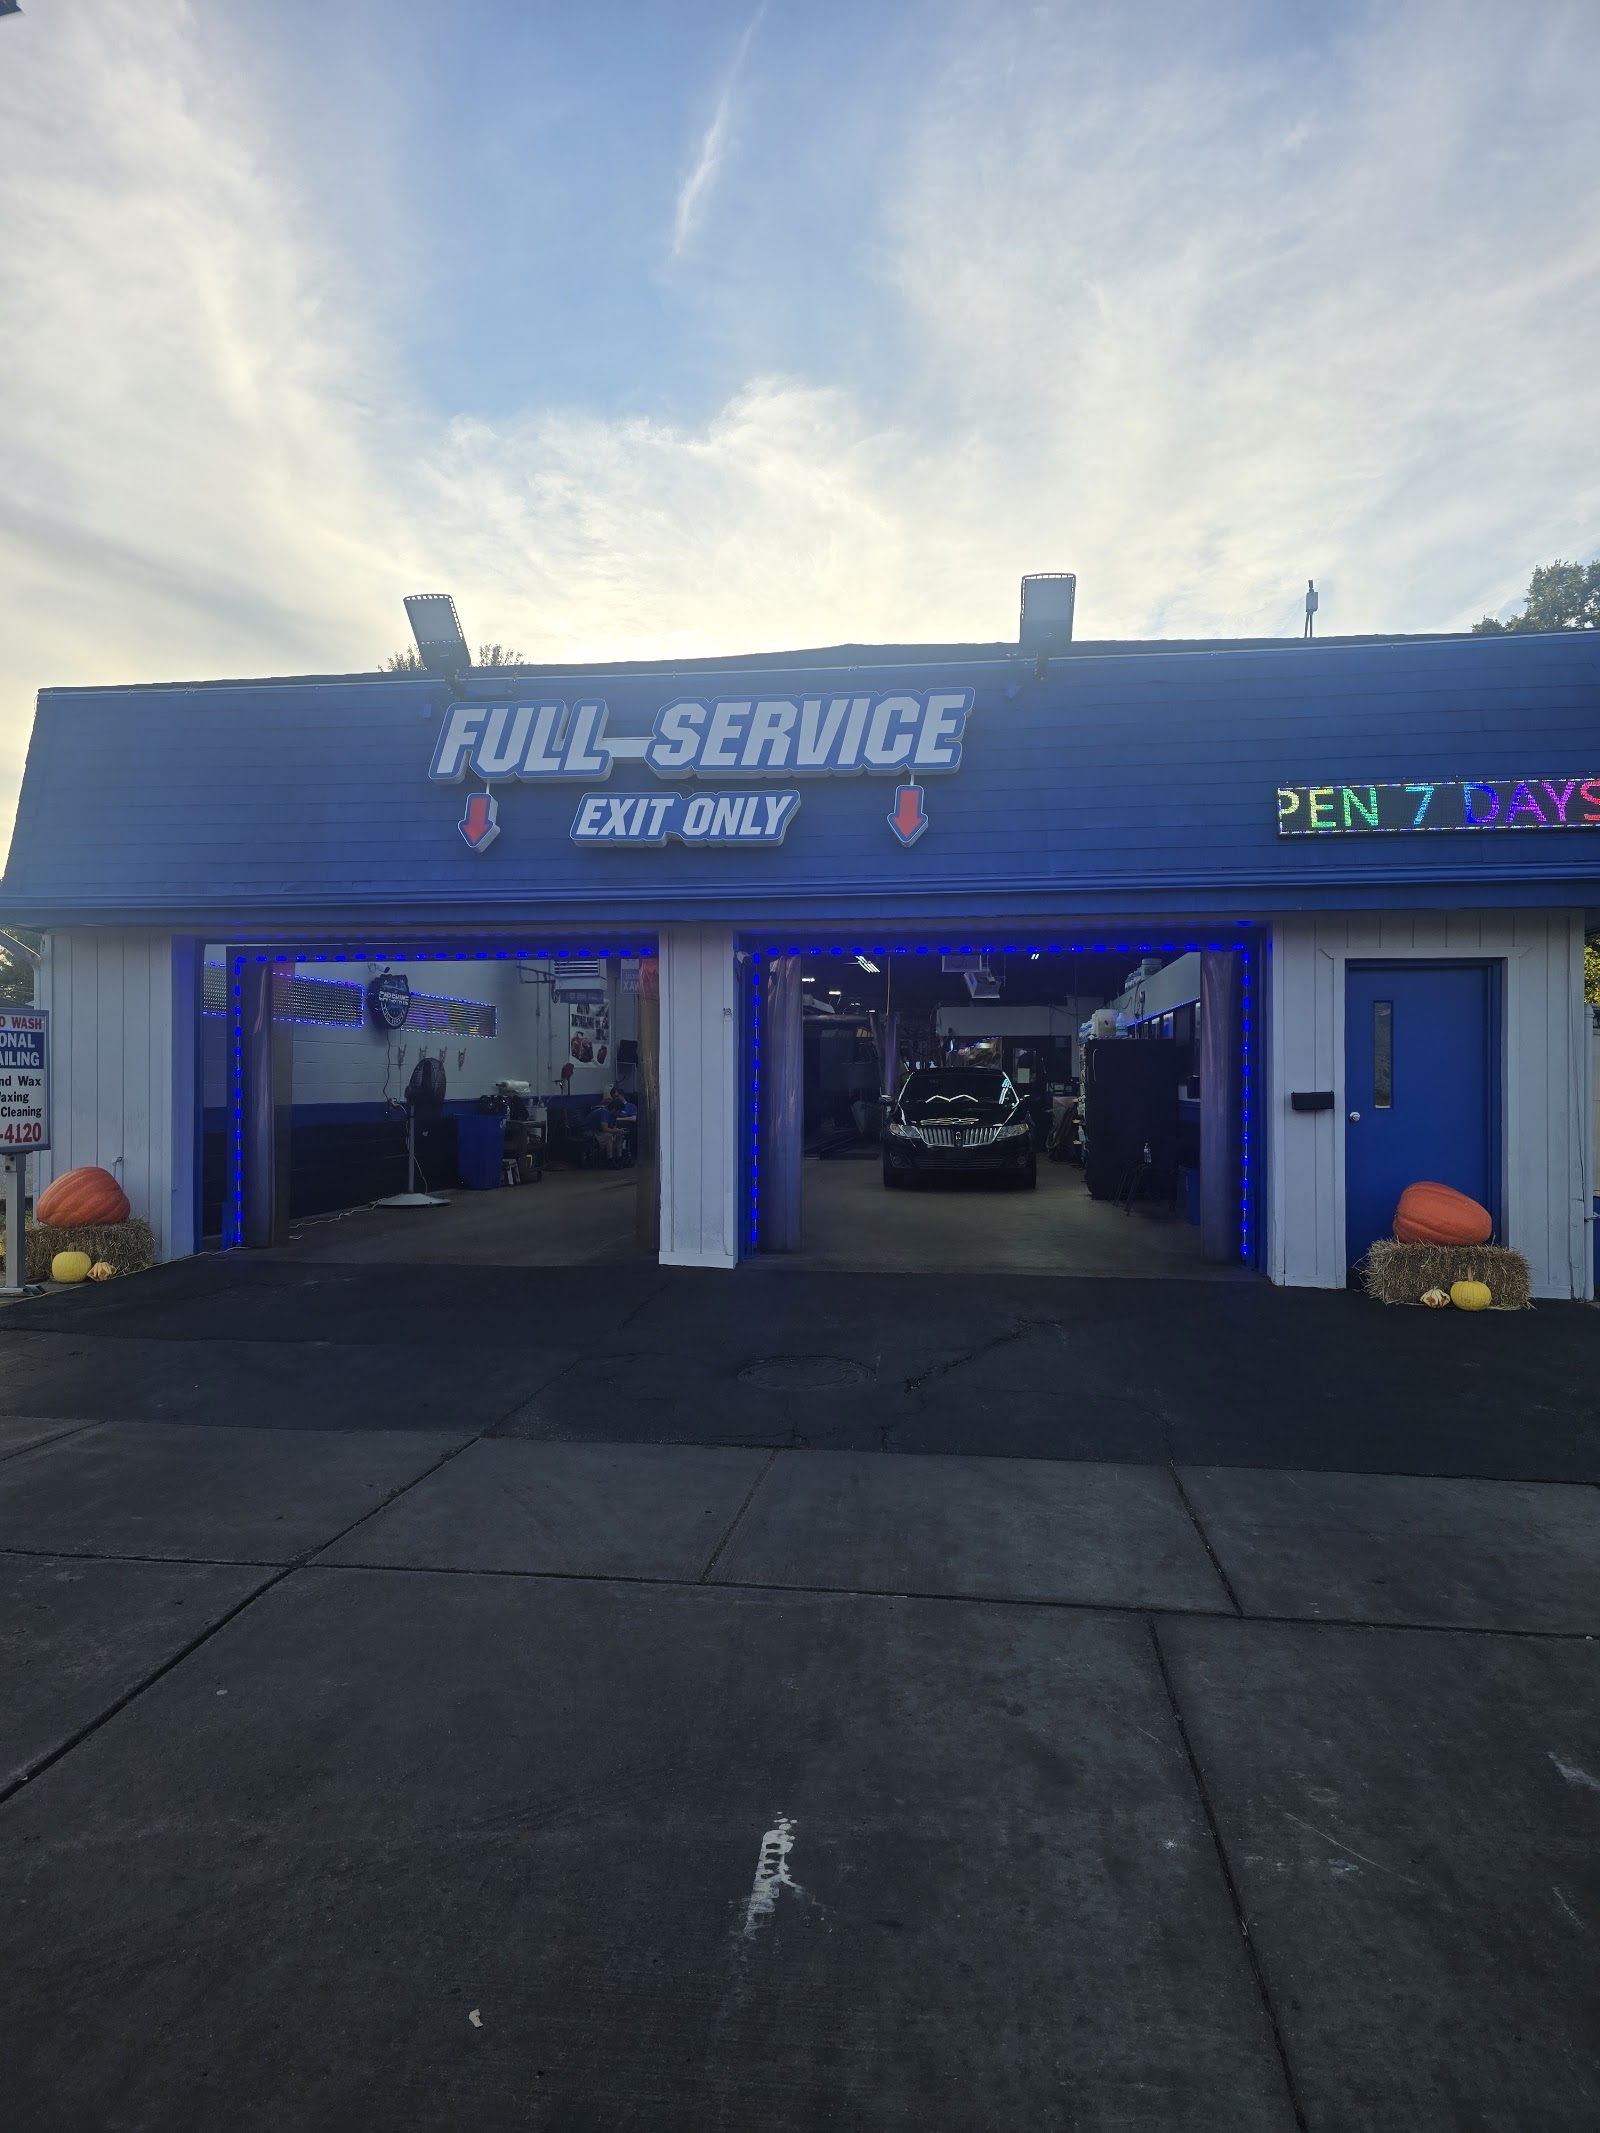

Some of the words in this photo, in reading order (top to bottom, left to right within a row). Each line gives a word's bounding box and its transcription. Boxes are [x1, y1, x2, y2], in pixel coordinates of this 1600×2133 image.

[436, 705, 604, 774] FULL
[651, 694, 966, 766] SERVICE
[1277, 787, 1379, 828] PEN
[1405, 785, 1435, 825] 7
[1463, 780, 1600, 825] DAYS
[576, 798, 675, 836] EXIT
[682, 795, 794, 836] ONLY
[11, 1016, 42, 1030] WASH
[18, 1075, 42, 1087] Wax
[0, 1091, 29, 1104] axing
[1, 1106, 42, 1119] Cleaning
